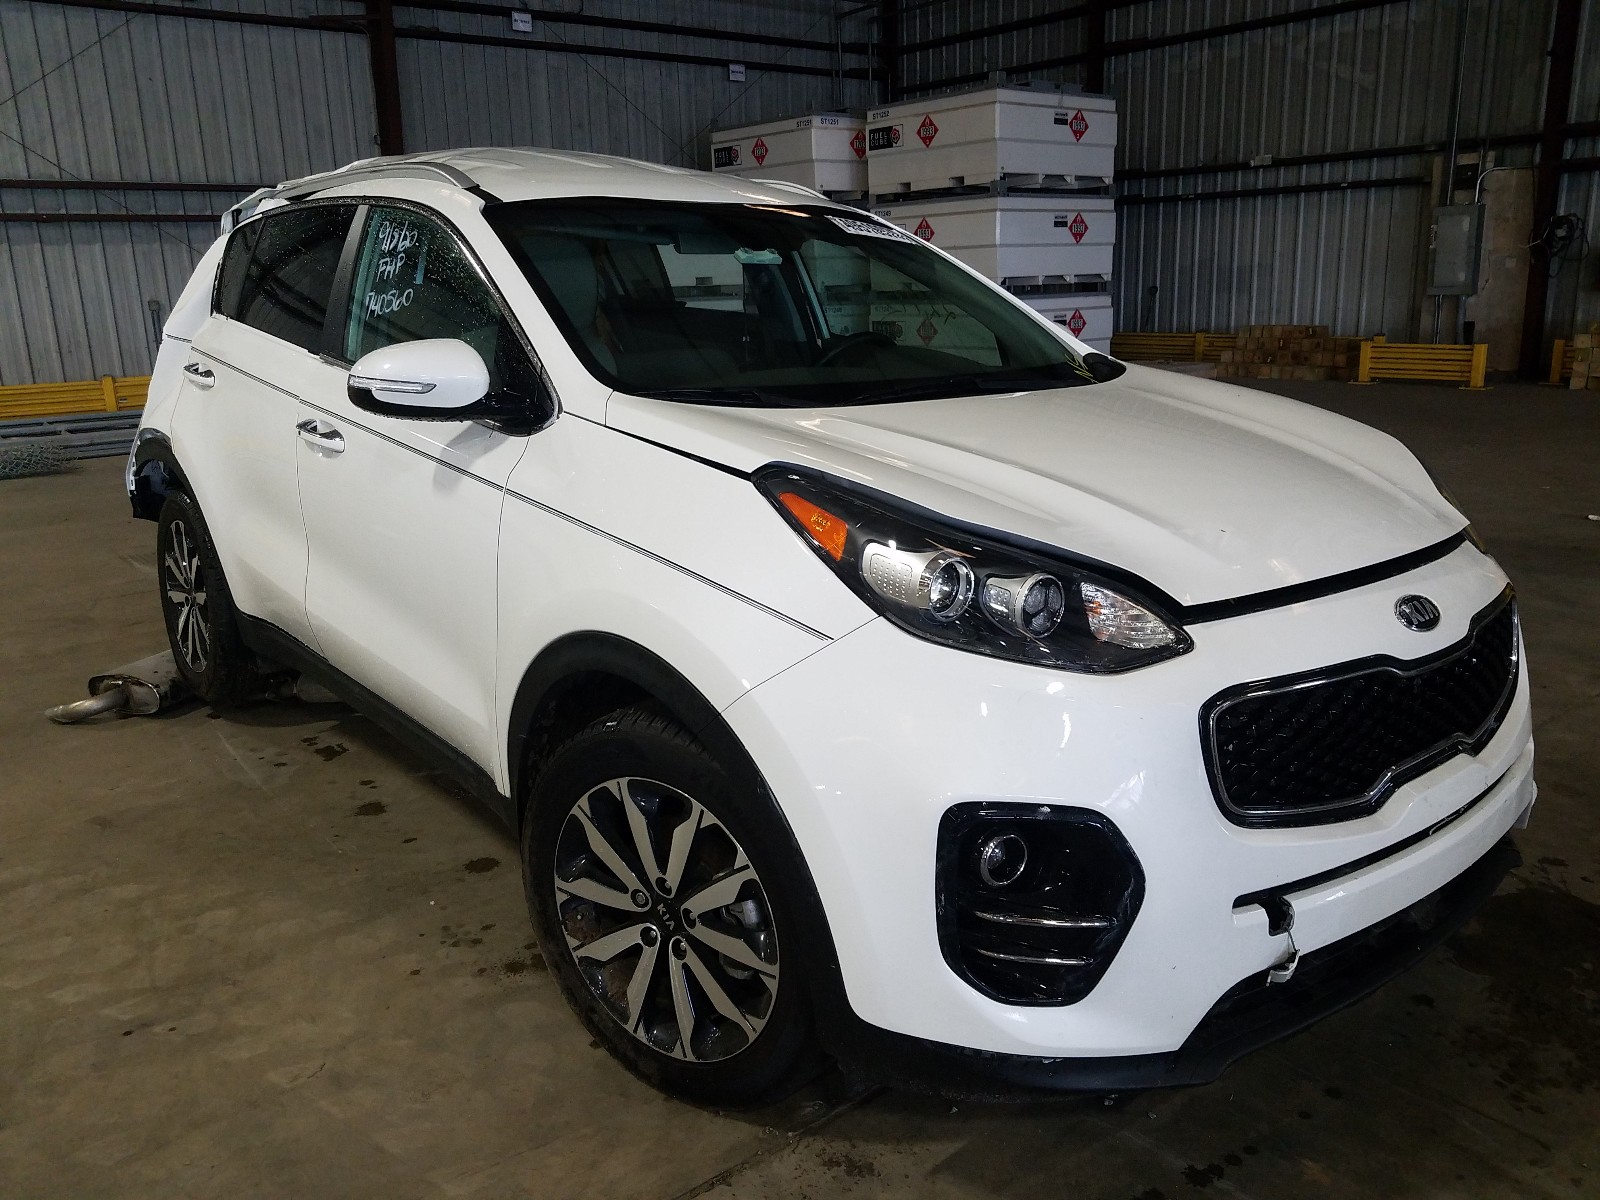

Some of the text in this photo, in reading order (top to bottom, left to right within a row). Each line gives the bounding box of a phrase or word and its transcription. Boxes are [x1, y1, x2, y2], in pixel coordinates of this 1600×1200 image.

[872, 110, 890, 120] ST1252
[820, 117, 839, 125] ST1251
[870, 131, 888, 140] FUEL
[870, 137, 888, 146] CUBE
[366, 288, 413, 321] 740560
[1400, 598, 1439, 625] KIA
[657, 903, 675, 931] KIA
